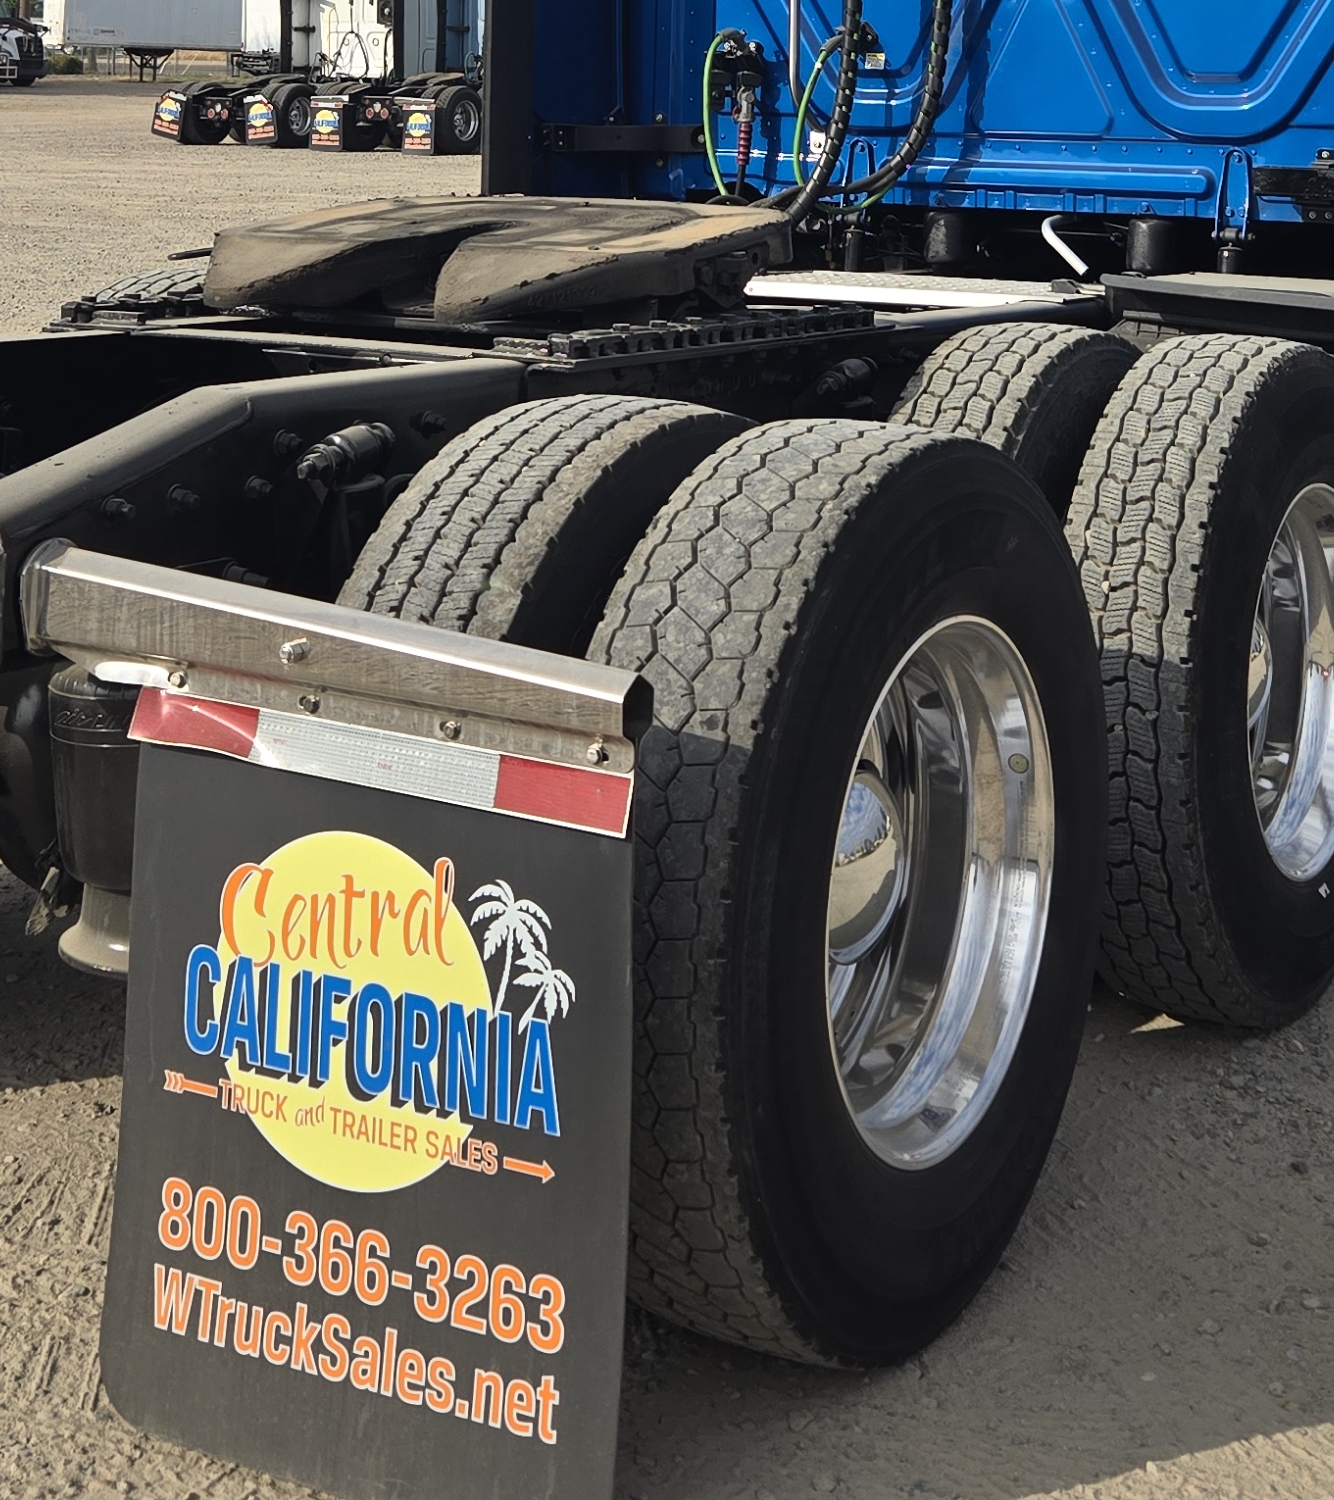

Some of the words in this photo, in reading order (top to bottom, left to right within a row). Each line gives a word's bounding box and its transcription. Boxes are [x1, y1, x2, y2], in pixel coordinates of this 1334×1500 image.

[220, 856, 455, 968] Central
[183, 944, 561, 1138] CALIFORNIA
[219, 1077, 288, 1123] TRUCK
[294, 1095, 326, 1129] and
[329, 1106, 418, 1155] TRAILER
[424, 1130, 499, 1176] SALES
[153, 1262, 560, 1445] WTruckSales.net
[157, 1177, 566, 1355] 800-366-3263
